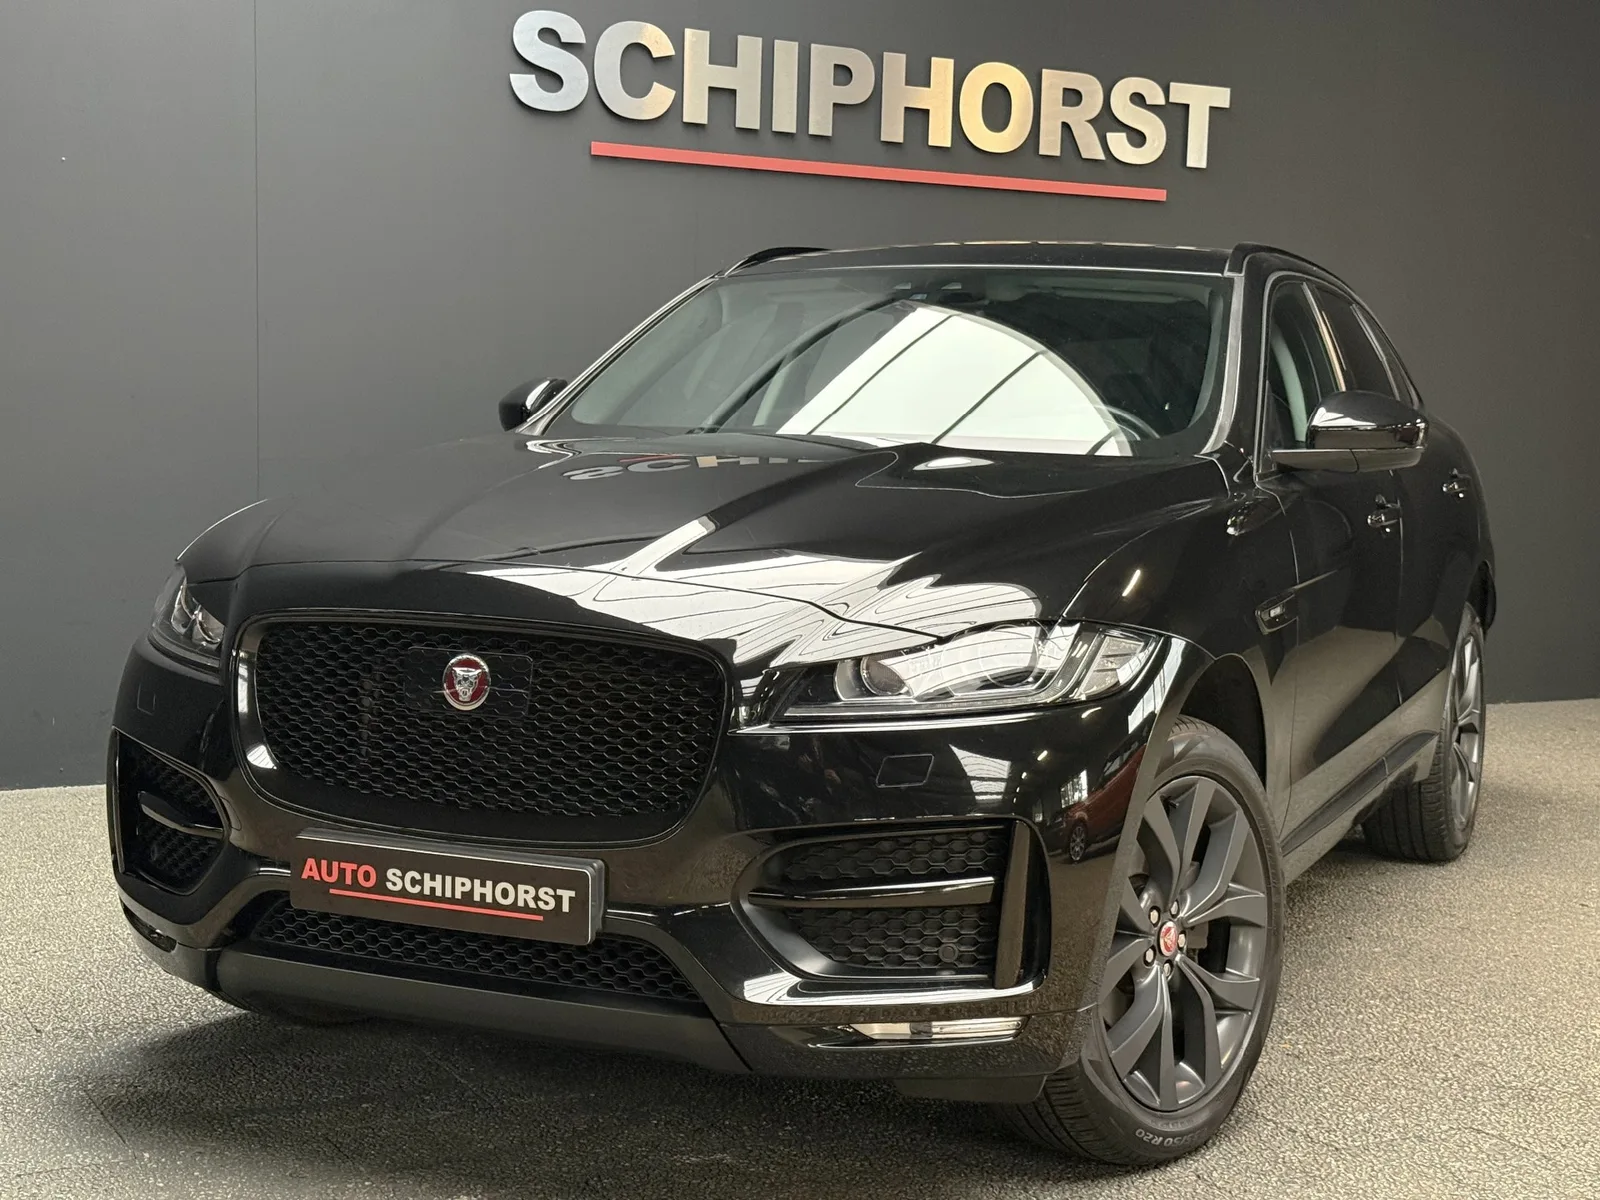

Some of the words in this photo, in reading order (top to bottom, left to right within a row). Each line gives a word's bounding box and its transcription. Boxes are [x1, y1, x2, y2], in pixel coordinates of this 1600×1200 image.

[509, 10, 1231, 169] SCHIPHORST
[301, 857, 377, 888] AUTO
[385, 868, 576, 913] SCHIPHORST
